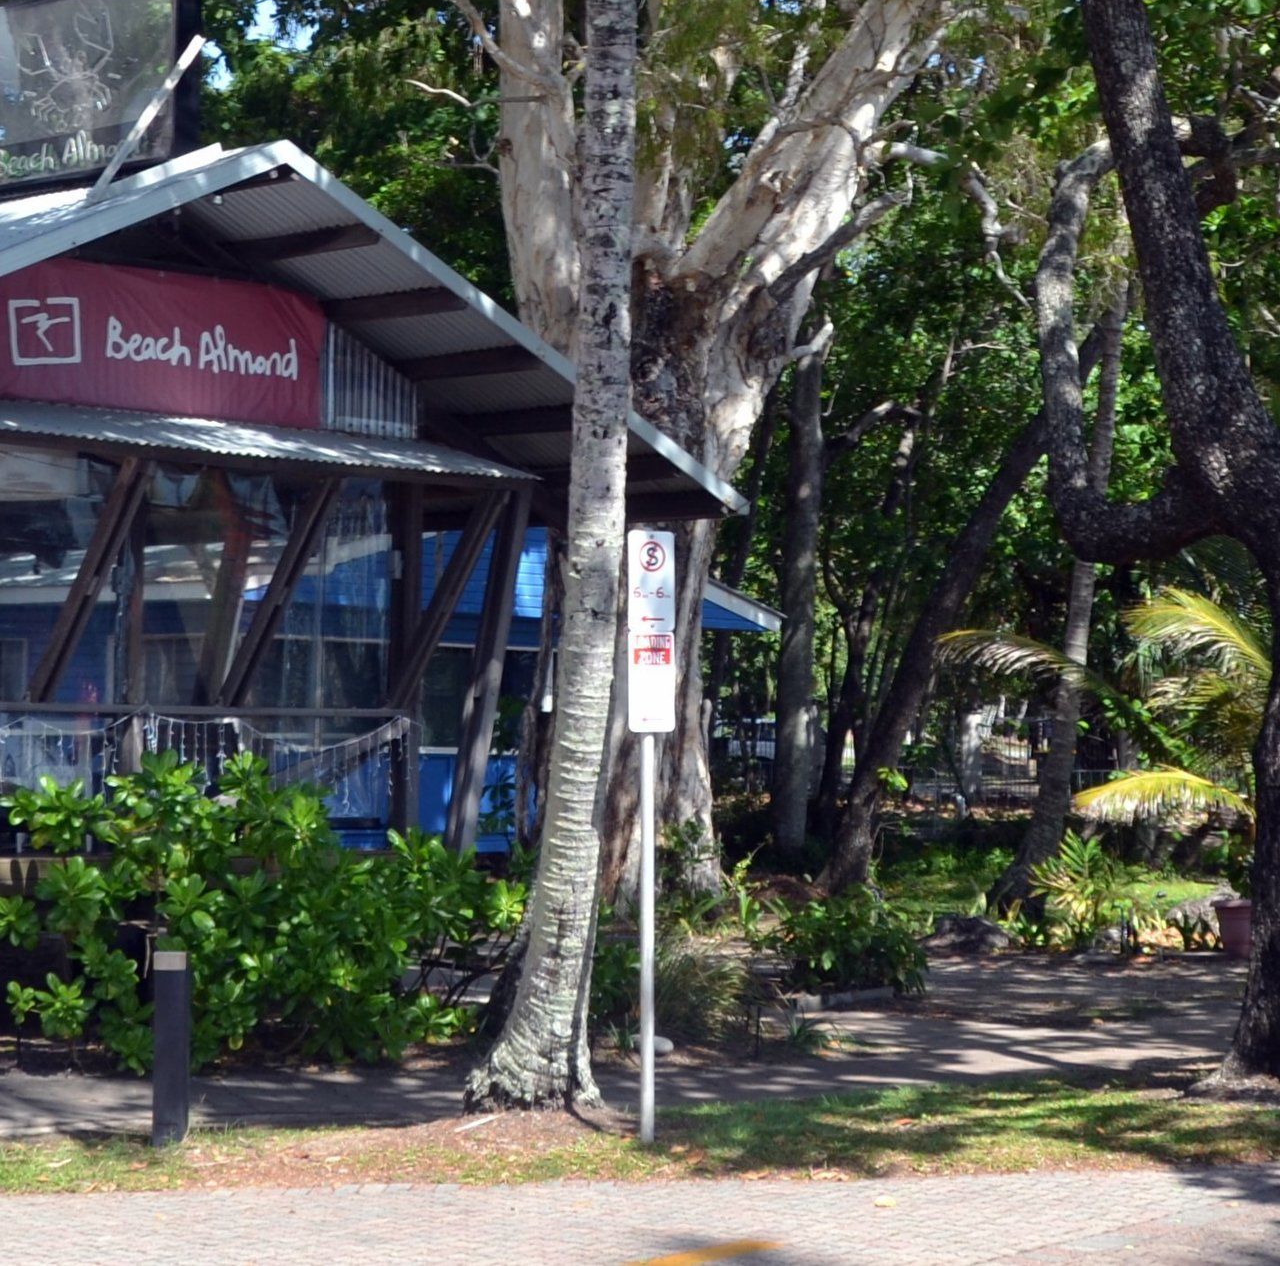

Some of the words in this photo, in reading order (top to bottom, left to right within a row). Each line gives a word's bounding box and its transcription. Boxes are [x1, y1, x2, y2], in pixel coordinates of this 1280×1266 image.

[62, 129, 140, 167] Almo
[106, 316, 191, 366] Beach
[199, 324, 298, 381] Almond
[637, 650, 666, 665] ZONE
